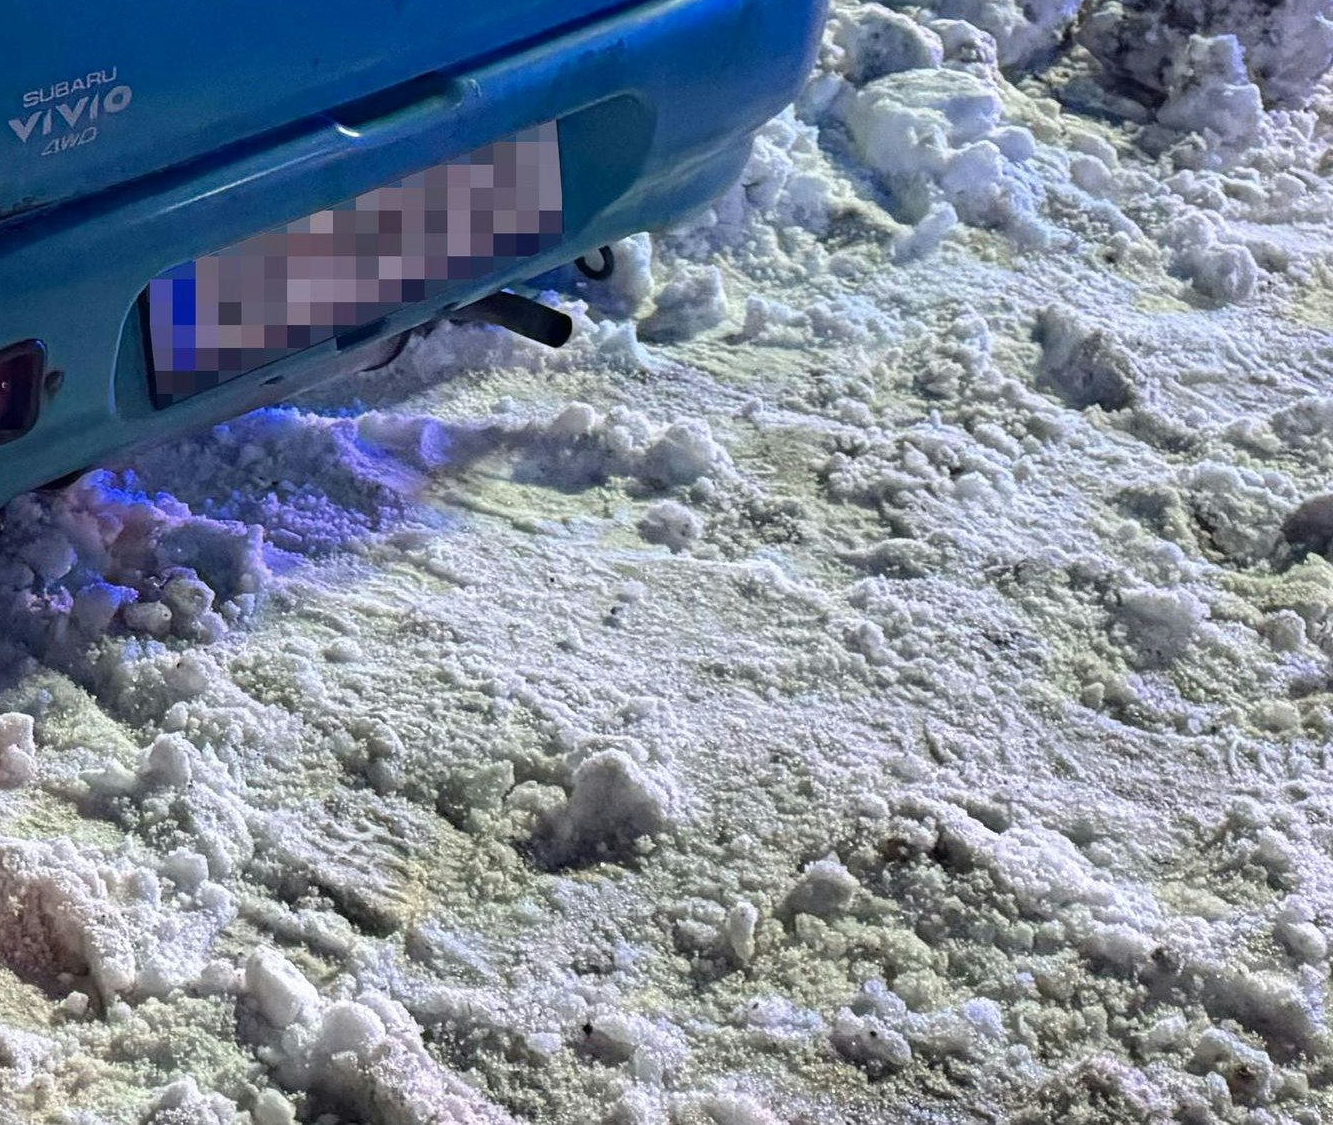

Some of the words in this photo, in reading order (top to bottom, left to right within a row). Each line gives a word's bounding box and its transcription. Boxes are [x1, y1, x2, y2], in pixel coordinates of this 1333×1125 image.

[23, 65, 117, 108] SUBARU
[8, 85, 133, 144] VIVIO
[41, 126, 98, 156] 4WD
